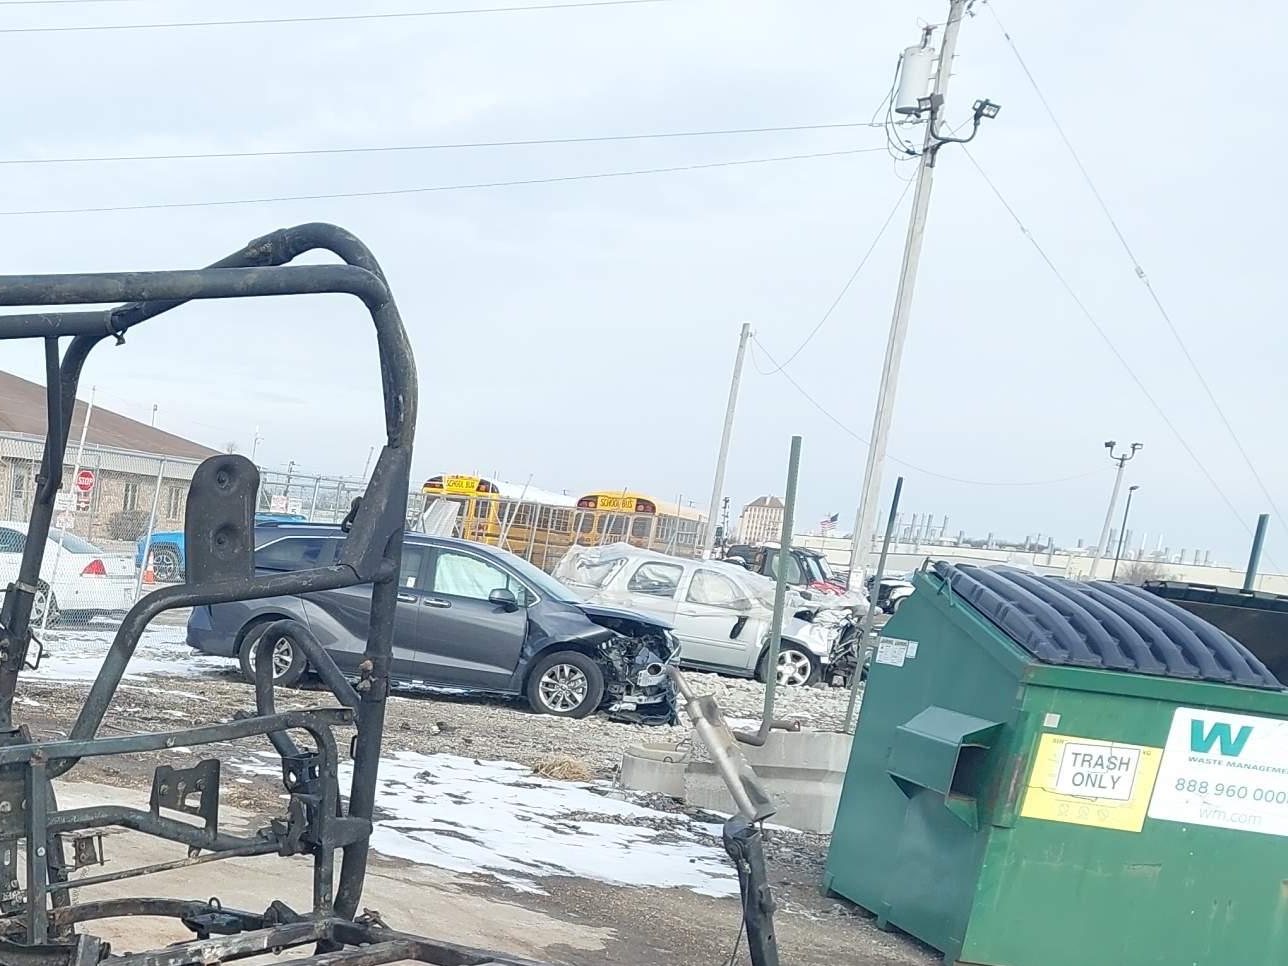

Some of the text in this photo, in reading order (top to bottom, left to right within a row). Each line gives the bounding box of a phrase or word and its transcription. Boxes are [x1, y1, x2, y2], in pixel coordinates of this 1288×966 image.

[78, 476, 93, 486] STOP
[1071, 752, 1131, 772] TRASH
[1188, 756, 1288, 775] WASTE MANAGEME
[1071, 771, 1123, 790] ONLY
[1175, 777, 1288, 804] 888 960 000
[1199, 807, 1263, 825] wm.com
